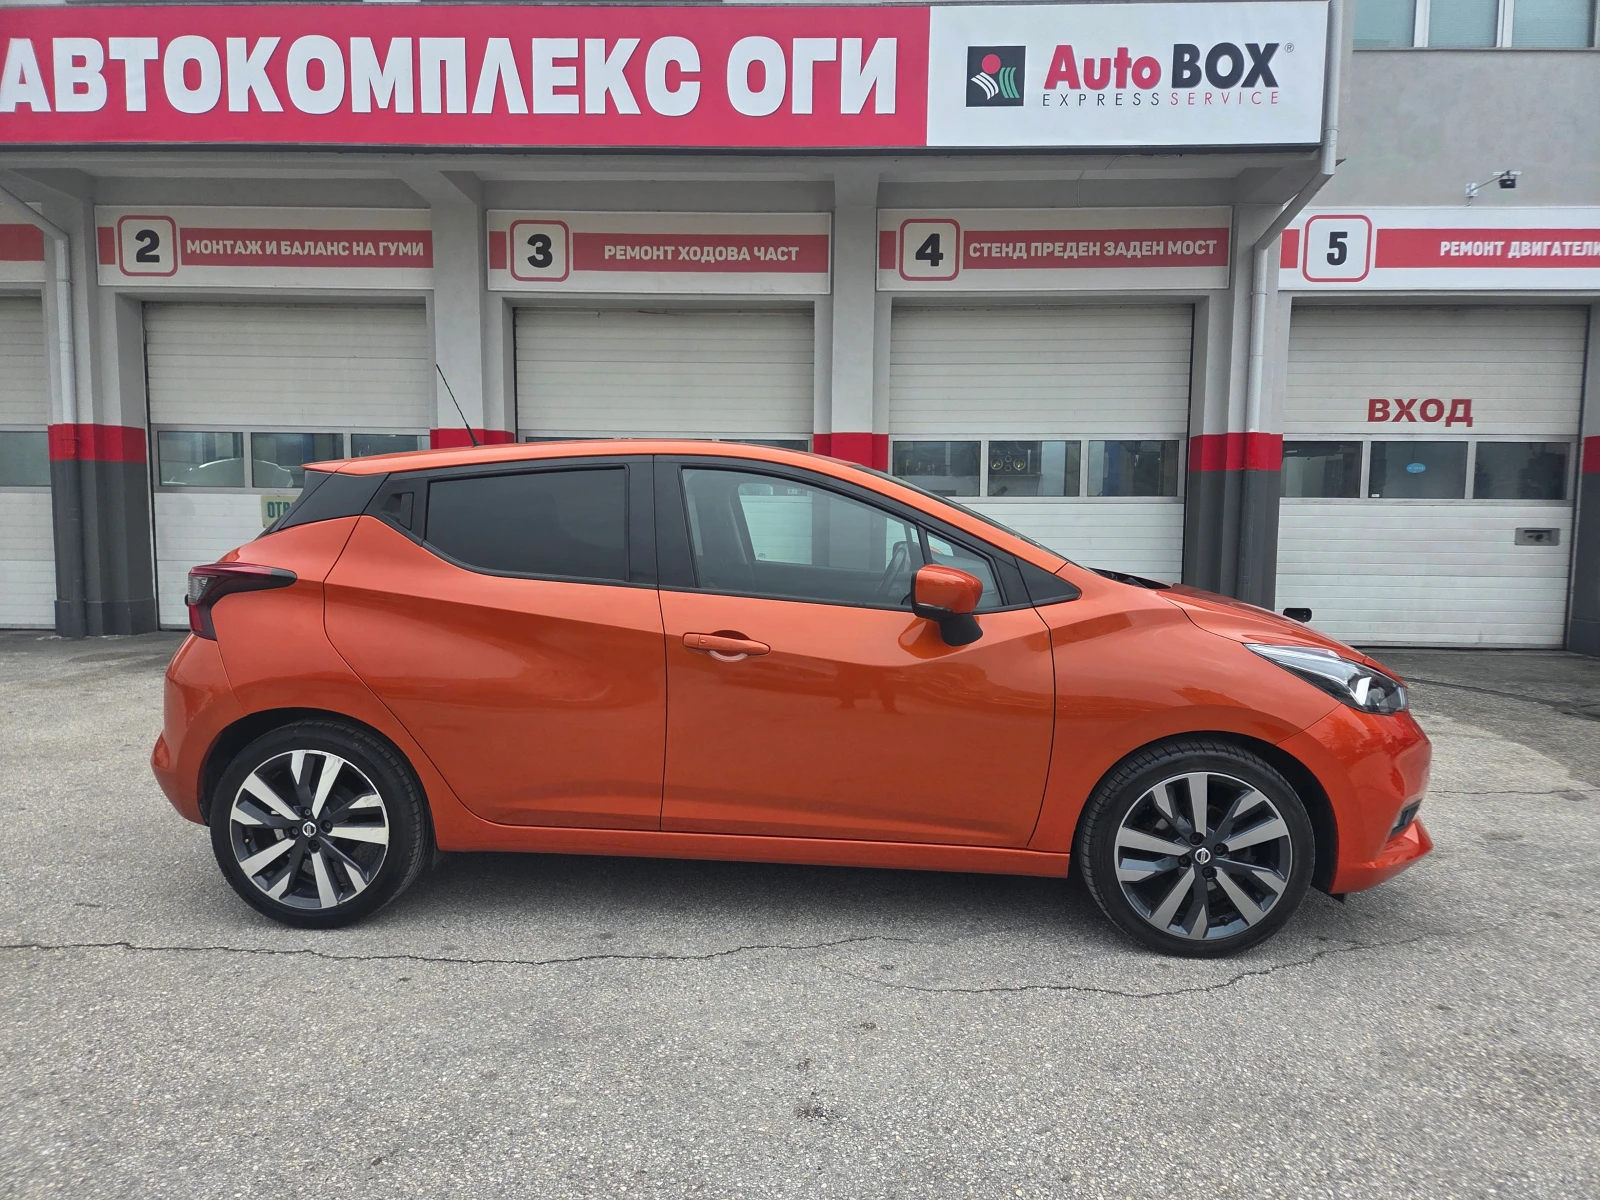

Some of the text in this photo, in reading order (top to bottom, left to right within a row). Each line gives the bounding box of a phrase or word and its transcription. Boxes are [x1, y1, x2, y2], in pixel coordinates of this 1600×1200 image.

[0, 35, 897, 117] АВТОКОМПЛЕКС ОГИ
[1044, 42, 1280, 90] Auto BOX
[1042, 91, 1279, 107] EXPRESS SERVICE
[135, 229, 161, 263] 2
[186, 239, 424, 257] МОНТАЖ И БАЛАНС НА ГУМИ
[526, 234, 554, 268] 3
[604, 245, 799, 263] РЕМОНТ ХОДОВА ЧАСТ
[915, 233, 944, 267] 4
[969, 240, 1217, 260] СТЕНД ПРЕДЕН ЗАДЕН МОСТ
[1326, 231, 1348, 265] 5
[1440, 241, 1505, 257] РЕМОНТ
[1367, 398, 1474, 427] ВХОД
